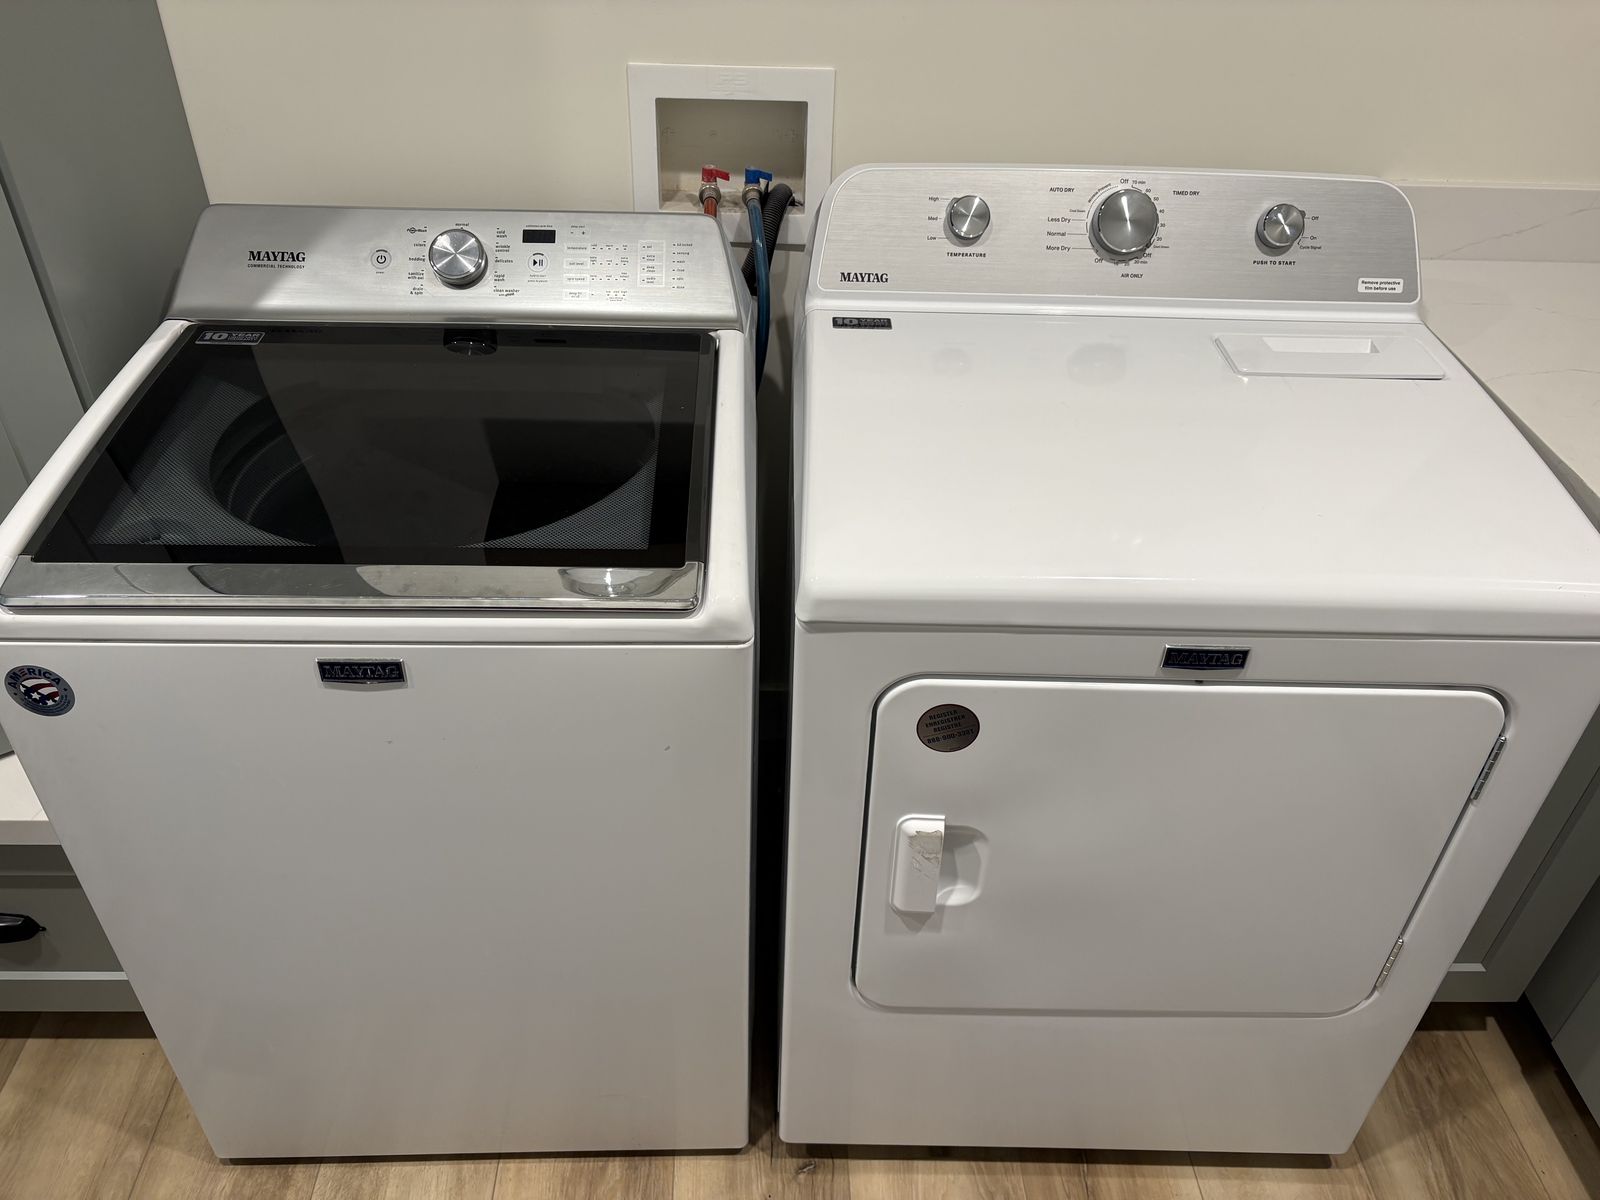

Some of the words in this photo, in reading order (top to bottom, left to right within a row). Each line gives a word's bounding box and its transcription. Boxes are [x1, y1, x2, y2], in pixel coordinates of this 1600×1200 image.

[248, 251, 306, 263] MAYTAG
[840, 272, 888, 283] MAYTAG
[1168, 652, 1243, 665] MAYTAG
[323, 665, 399, 678] MAYTAG
[8, 668, 60, 689] AMERICA
